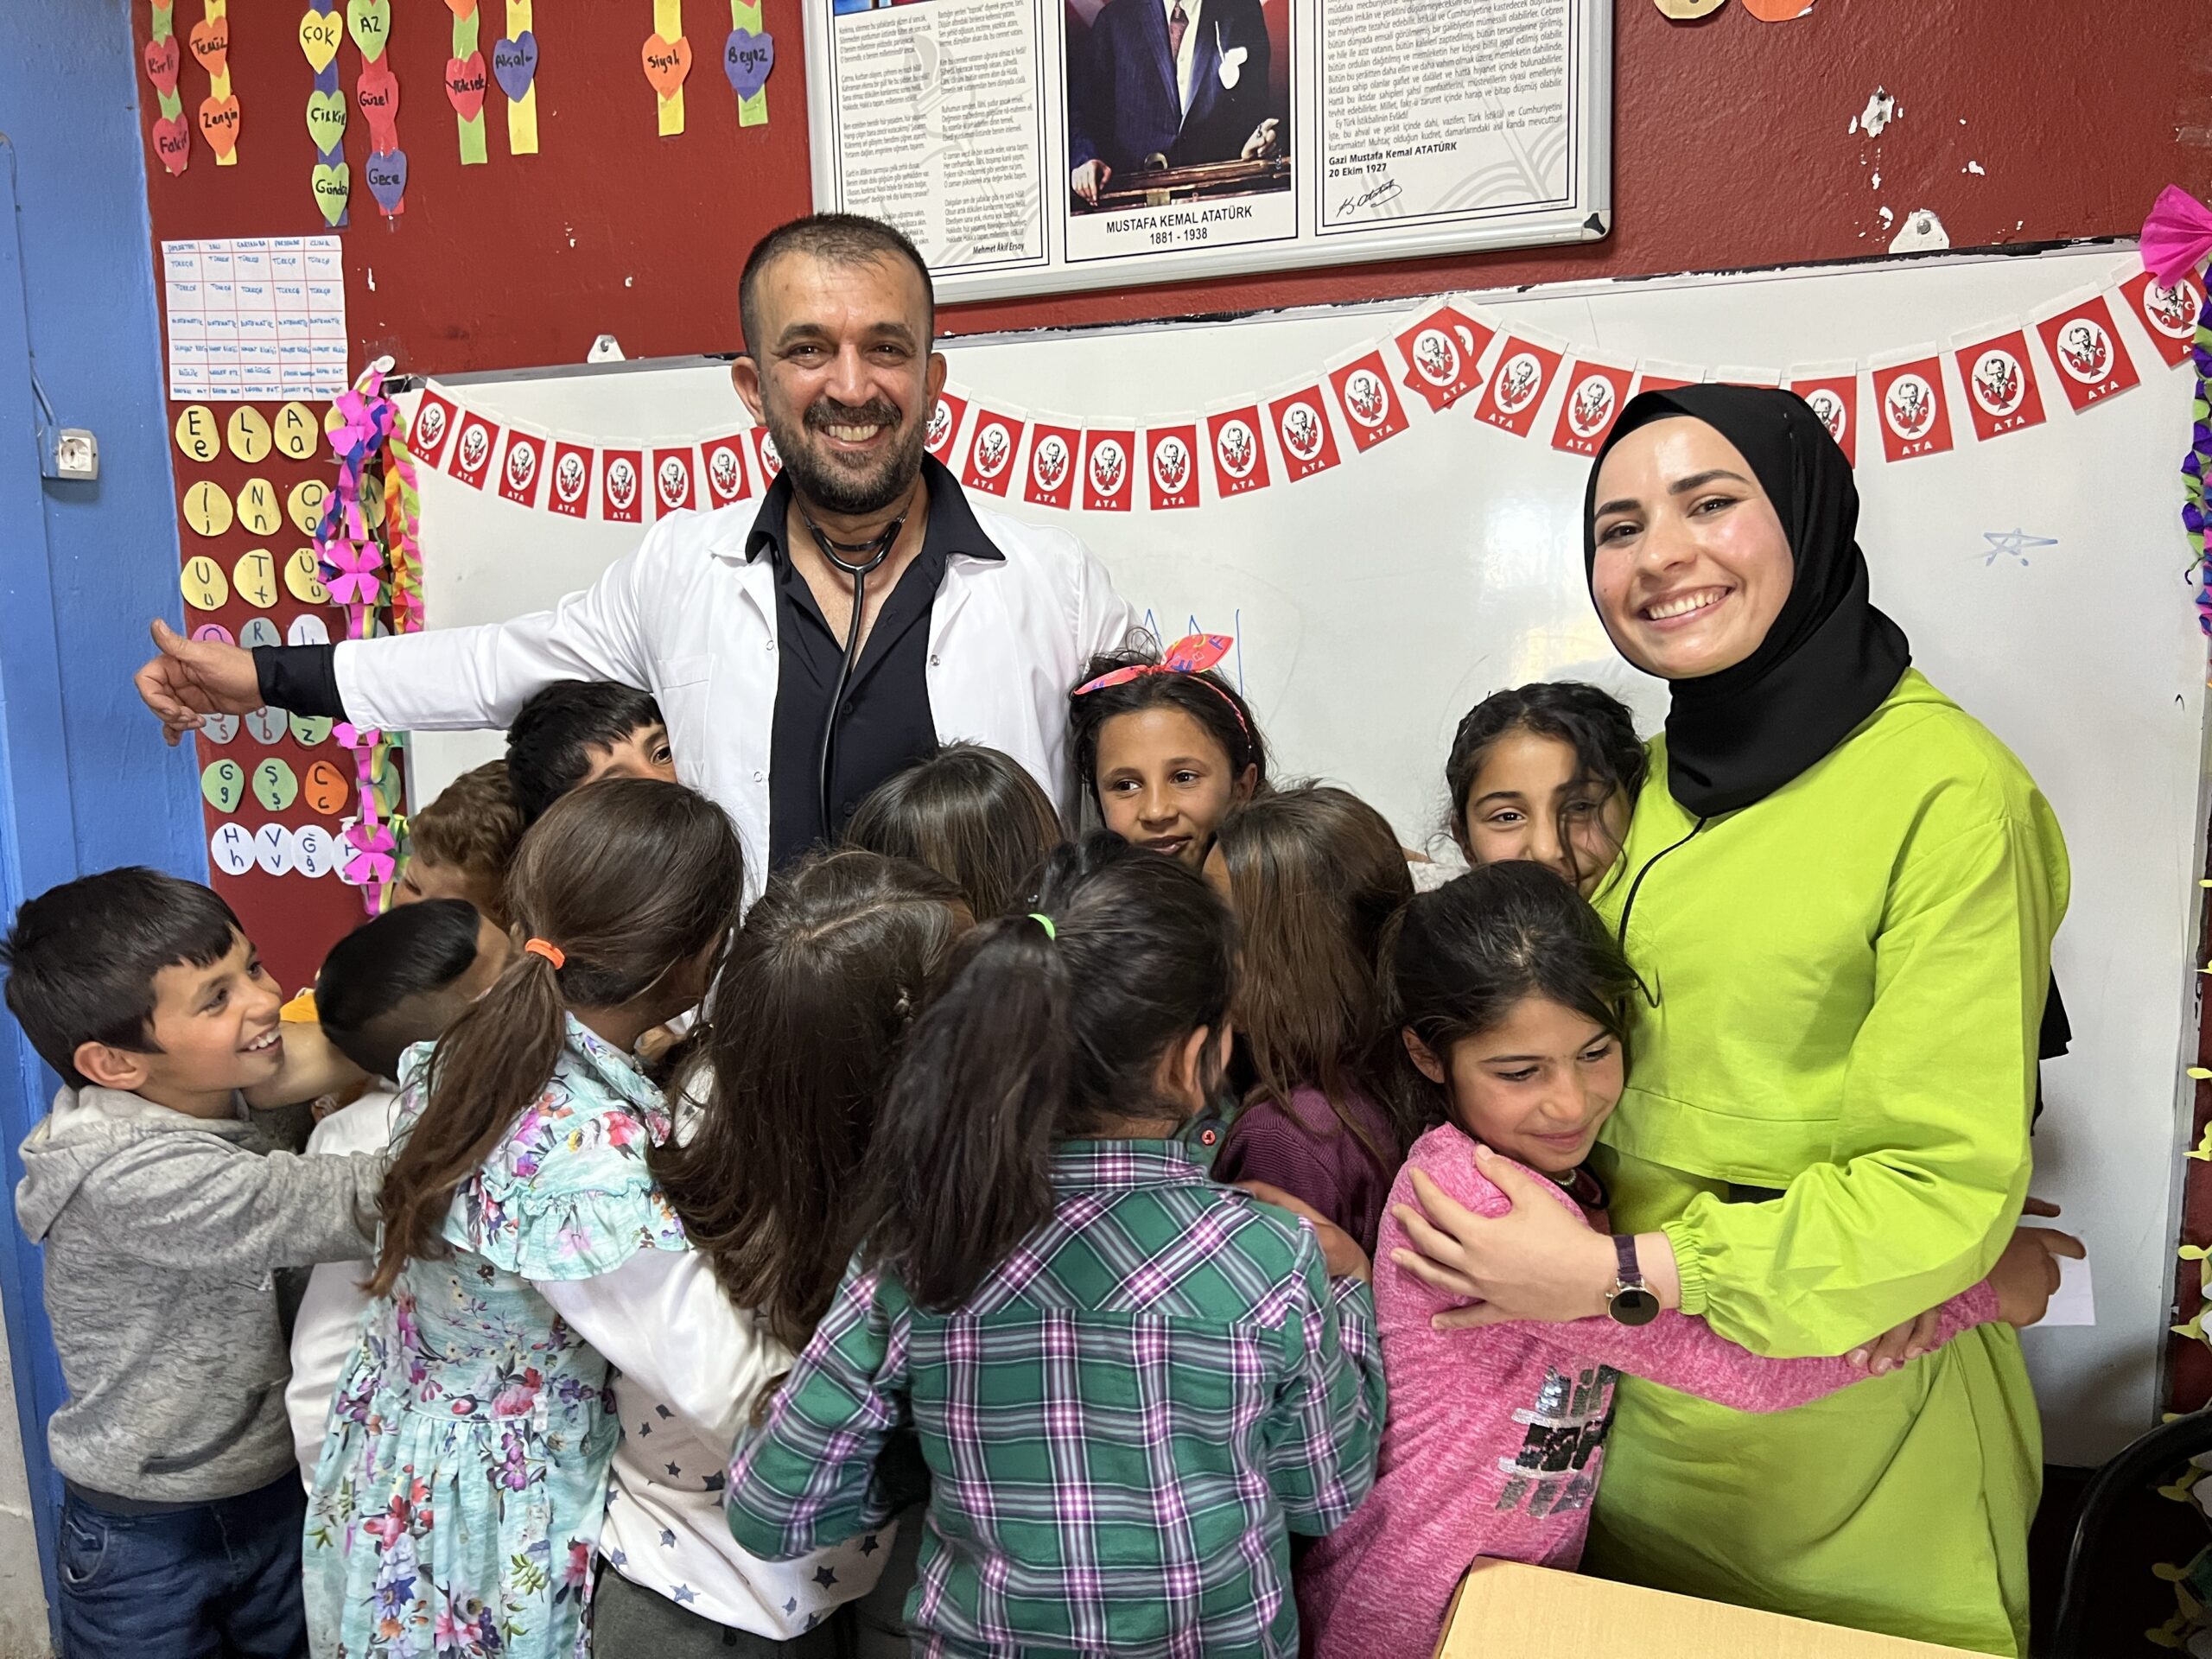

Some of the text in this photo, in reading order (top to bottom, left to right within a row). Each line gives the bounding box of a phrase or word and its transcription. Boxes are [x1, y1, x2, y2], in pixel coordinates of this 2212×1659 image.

[360, 16, 382, 33] AZ
[303, 26, 334, 48] ÇOK
[1329, 141, 1457, 166] Gazi Mustafa Kemal ATATÜRK
[369, 168, 401, 186] Gece
[1329, 162, 1387, 178] 20 Ekim 1927
[1106, 205, 1252, 233] MUSTAFA KEMAL ATATÜRK
[1150, 231, 1173, 245] 1881
[1184, 227, 1208, 242] 1938
[973, 245, 995, 255] Mehmet
[1009, 242, 1024, 252] Ersoy
[1442, 381, 1467, 401] ATA
[2088, 380, 2120, 400] ATA
[188, 410, 201, 435] E
[240, 412, 254, 434] L
[287, 409, 303, 429] A
[1488, 412, 1514, 429] ATA
[1993, 416, 2025, 432] ATA
[1369, 424, 1394, 442] ATA
[194, 439, 209, 458] e
[290, 435, 304, 453] a
[1566, 438, 1592, 453] ATA
[1902, 441, 1933, 455] ATA
[414, 447, 429, 461] ATA
[1301, 460, 1325, 474] ATA
[456, 470, 474, 484] ATA
[972, 478, 994, 491] ATA
[1231, 479, 1255, 492] ATA
[251, 485, 264, 506] N
[302, 484, 323, 506] O
[507, 490, 524, 502] ATA
[1034, 493, 1057, 504] ATA
[1094, 499, 1117, 508] ATA
[1162, 496, 1185, 506] ATA
[557, 503, 575, 514] ATA
[254, 514, 267, 531] n
[305, 516, 317, 531] o
[249, 555, 270, 577] T
[299, 550, 315, 574] Ü
[195, 562, 210, 584] U
[254, 586, 268, 604] t
[309, 577, 321, 598] ü
[254, 621, 264, 642] R
[263, 718, 273, 741] b
[219, 764, 233, 780] G
[265, 766, 278, 786] Ş
[314, 766, 328, 785] C
[220, 786, 229, 804] g
[224, 828, 239, 843] H
[265, 828, 282, 848] V
[302, 833, 316, 854] Ğ
[230, 849, 245, 867] h
[270, 855, 281, 868] v
